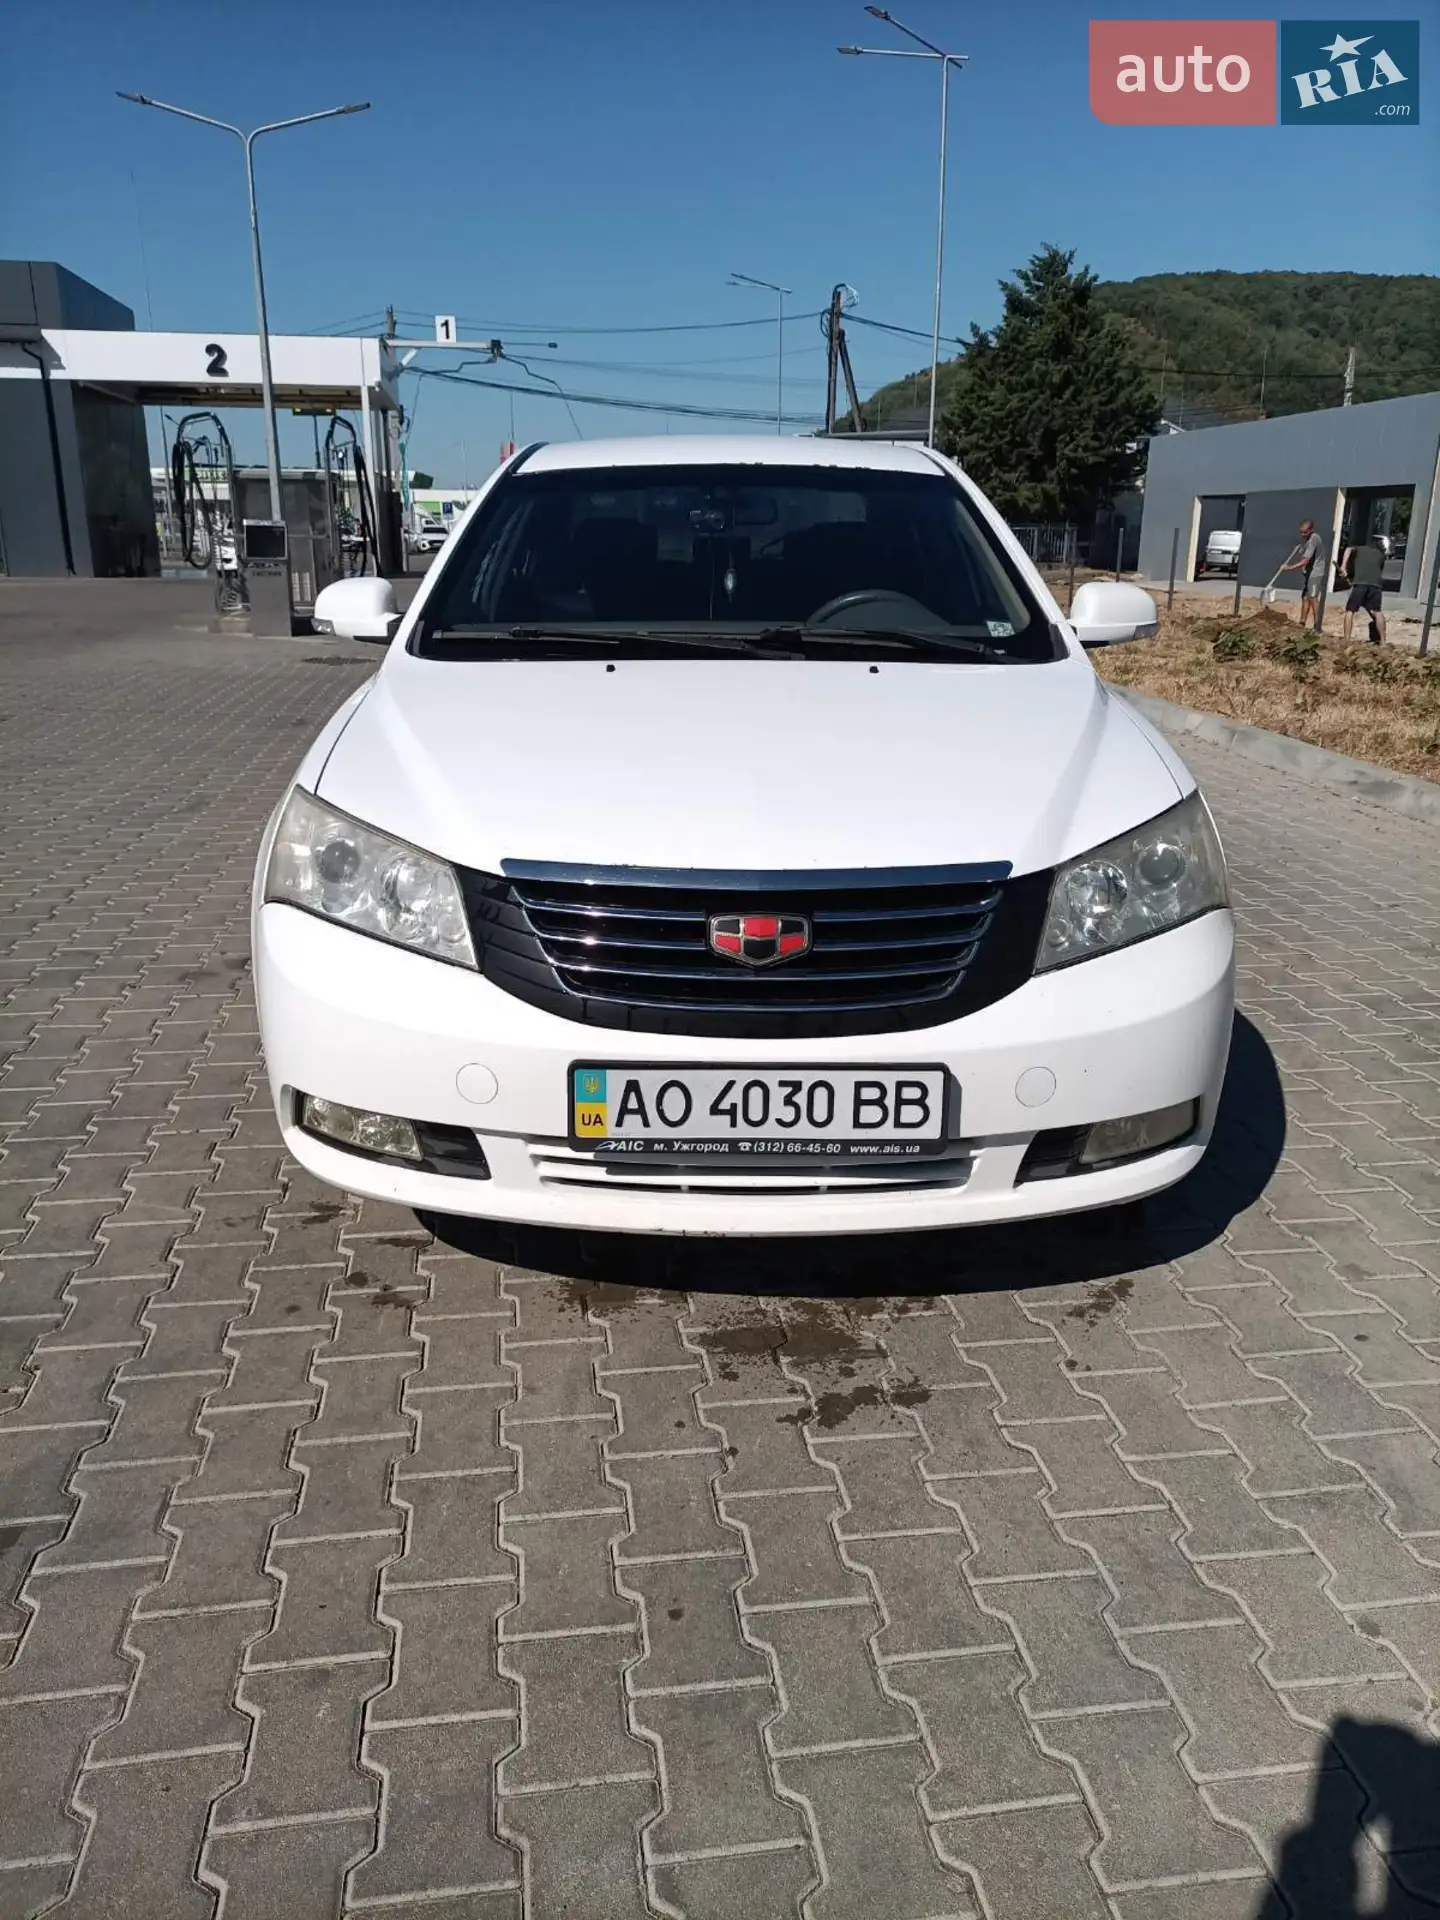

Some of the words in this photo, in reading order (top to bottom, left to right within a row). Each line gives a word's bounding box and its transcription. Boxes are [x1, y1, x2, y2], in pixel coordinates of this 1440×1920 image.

[440, 319, 451, 340] 1
[205, 343, 229, 377] 2
[615, 1079, 693, 1128] AO
[709, 1079, 835, 1128] 4030
[852, 1080, 930, 1129] BB
[581, 1113, 604, 1127] UA
[673, 1141, 729, 1153] Ужгород
[753, 1142, 785, 1153] (312)
[787, 1143, 841, 1153] 66-45-60
[850, 1144, 921, 1154] www.ais.ua
